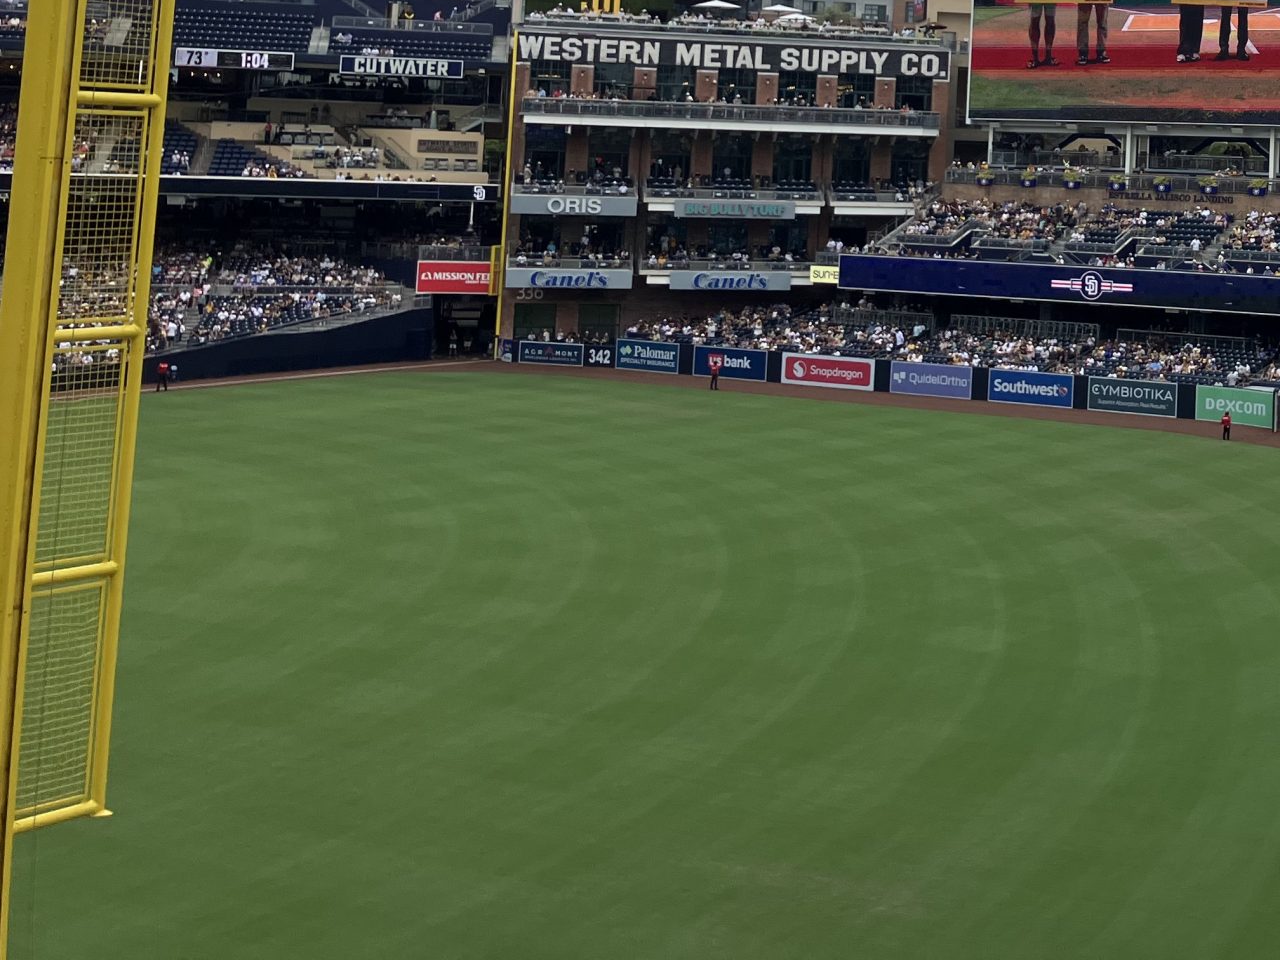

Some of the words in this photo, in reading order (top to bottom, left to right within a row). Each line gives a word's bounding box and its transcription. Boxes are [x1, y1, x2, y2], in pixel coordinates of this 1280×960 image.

[241, 52, 269, 69] 1:04
[518, 35, 661, 65] WESTERN
[675, 43, 771, 70] METAL
[780, 48, 890, 74] SUPPLY
[900, 53, 947, 77] CO.
[354, 57, 449, 76] CUTWATER
[1108, 191, 1153, 201] ESTRELLA
[1155, 192, 1191, 202] JALISCO
[1193, 194, 1234, 204] LANDING
[547, 198, 602, 214] ORIS
[751, 204, 785, 217] TURF
[433, 271, 474, 281] MISSION
[530, 271, 608, 287] Canel's
[694, 273, 768, 289] Canel's
[588, 348, 611, 364] 342
[634, 345, 676, 360] Palomar
[620, 357, 647, 365] SPECIALTY
[647, 359, 676, 368] INSURANCE
[724, 355, 752, 369] bank
[810, 365, 864, 380] Snapdragon
[909, 372, 968, 387] QuidelOrtho
[993, 378, 1059, 397] Southwest
[1091, 384, 1174, 402] CYMBIOTIKA
